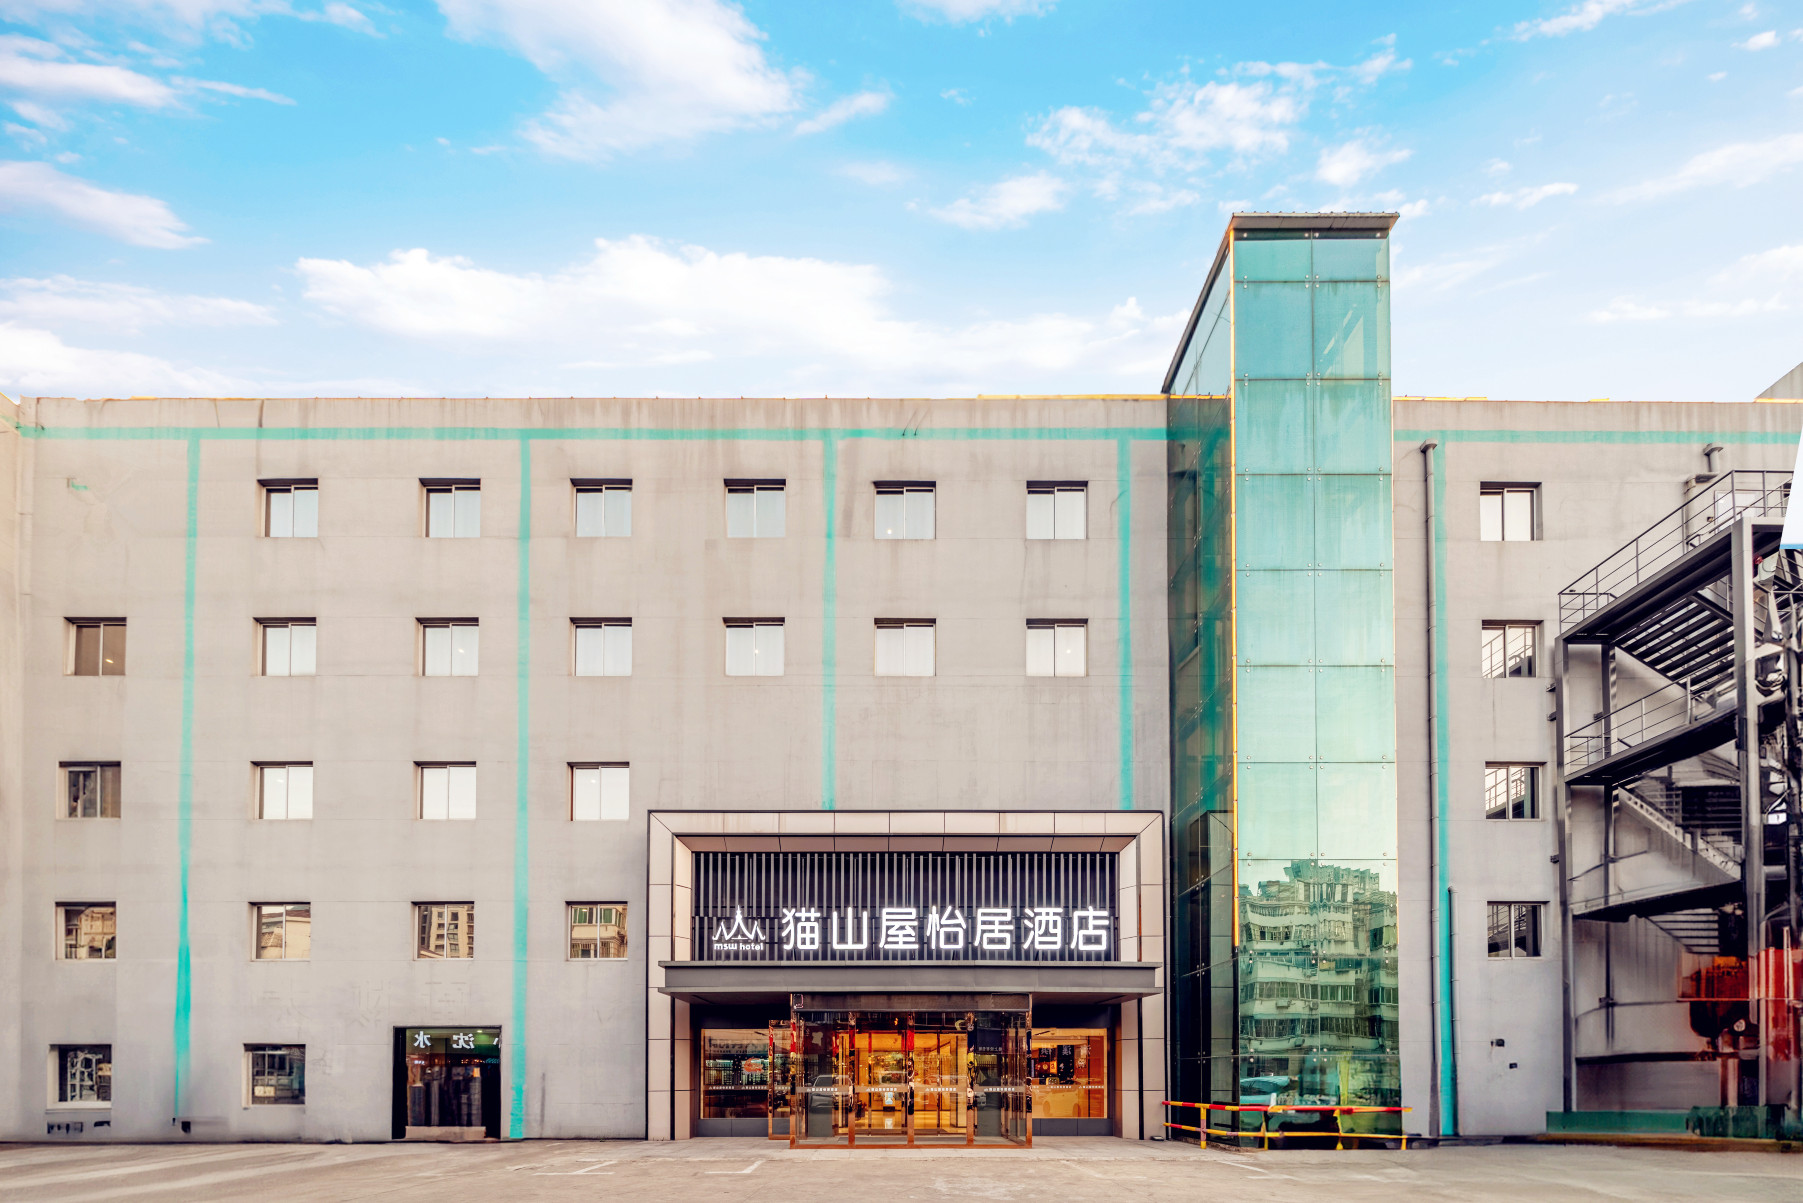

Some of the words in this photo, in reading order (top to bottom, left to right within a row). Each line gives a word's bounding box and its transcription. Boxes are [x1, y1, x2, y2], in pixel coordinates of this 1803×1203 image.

[781, 905, 1110, 951] 猫山屋怡居酒店
[739, 942, 764, 951] hotel
